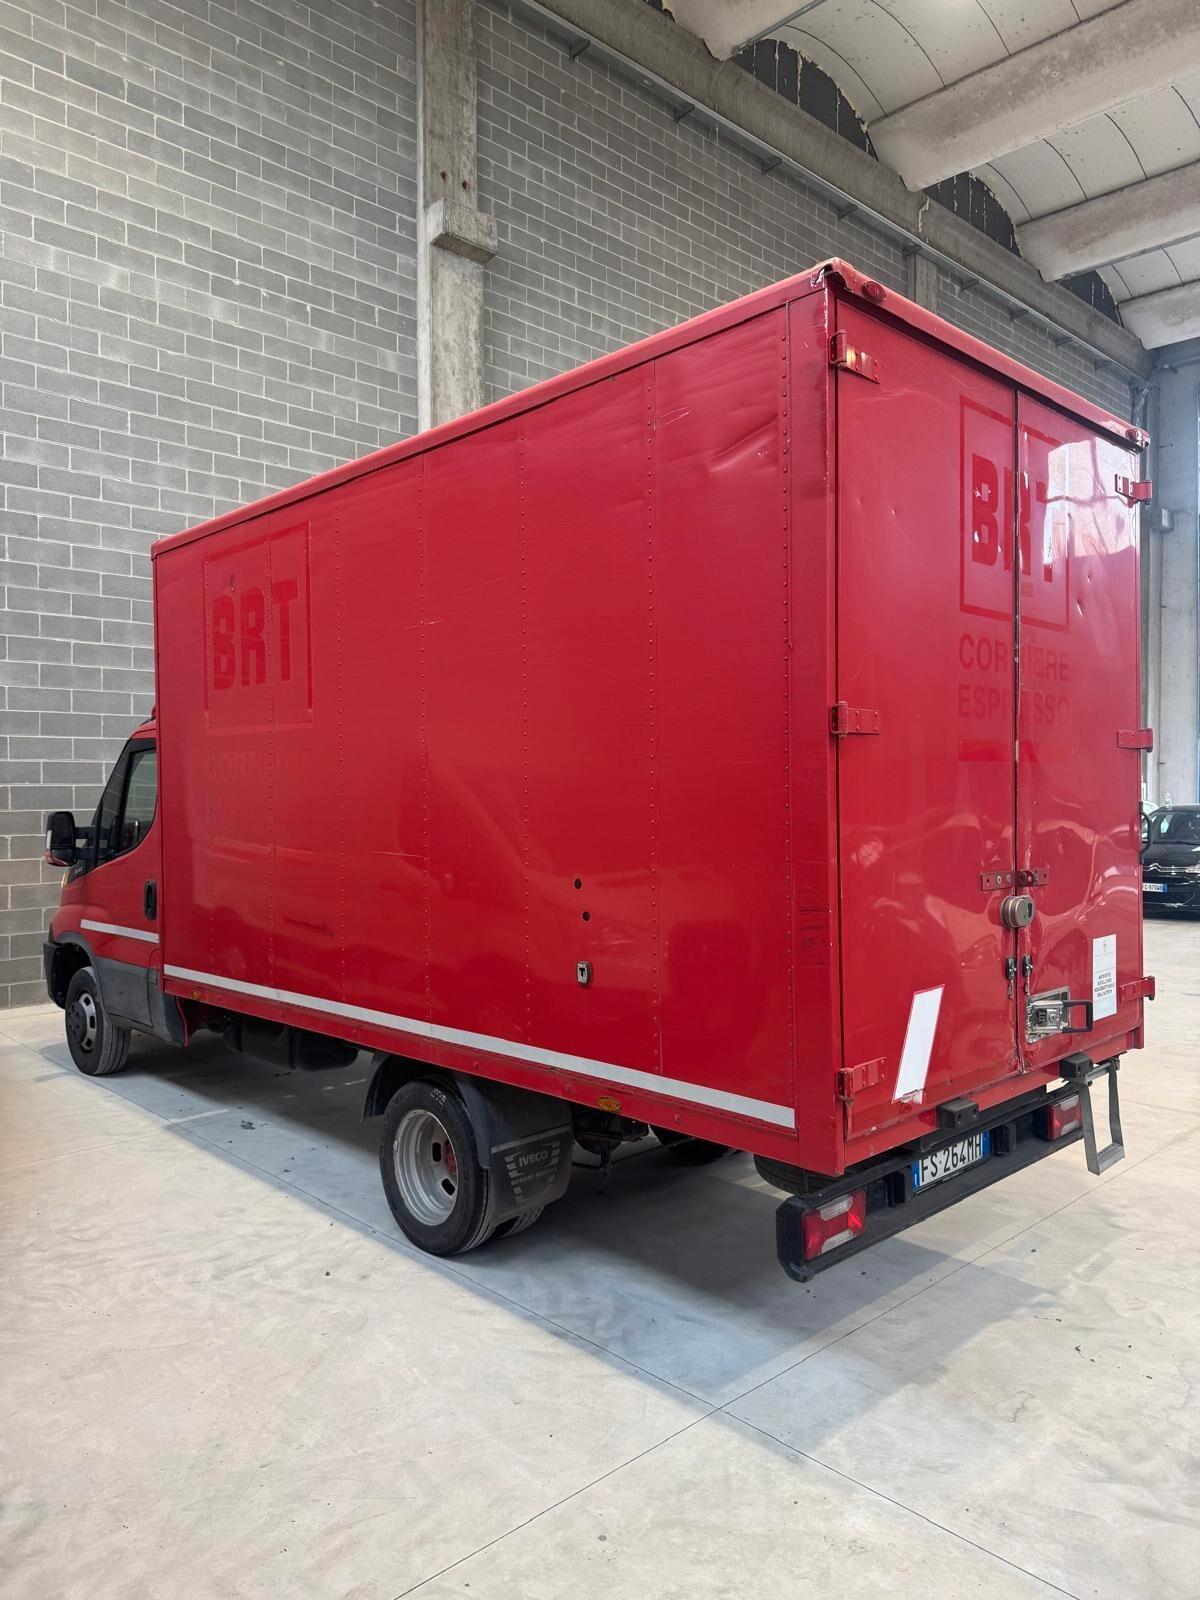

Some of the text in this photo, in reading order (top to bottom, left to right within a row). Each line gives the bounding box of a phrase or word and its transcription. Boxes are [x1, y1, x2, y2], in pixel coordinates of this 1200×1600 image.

[212, 577, 299, 691] BRT
[959, 633, 1070, 682] CORIERE
[518, 1150, 549, 1168] IVECO
